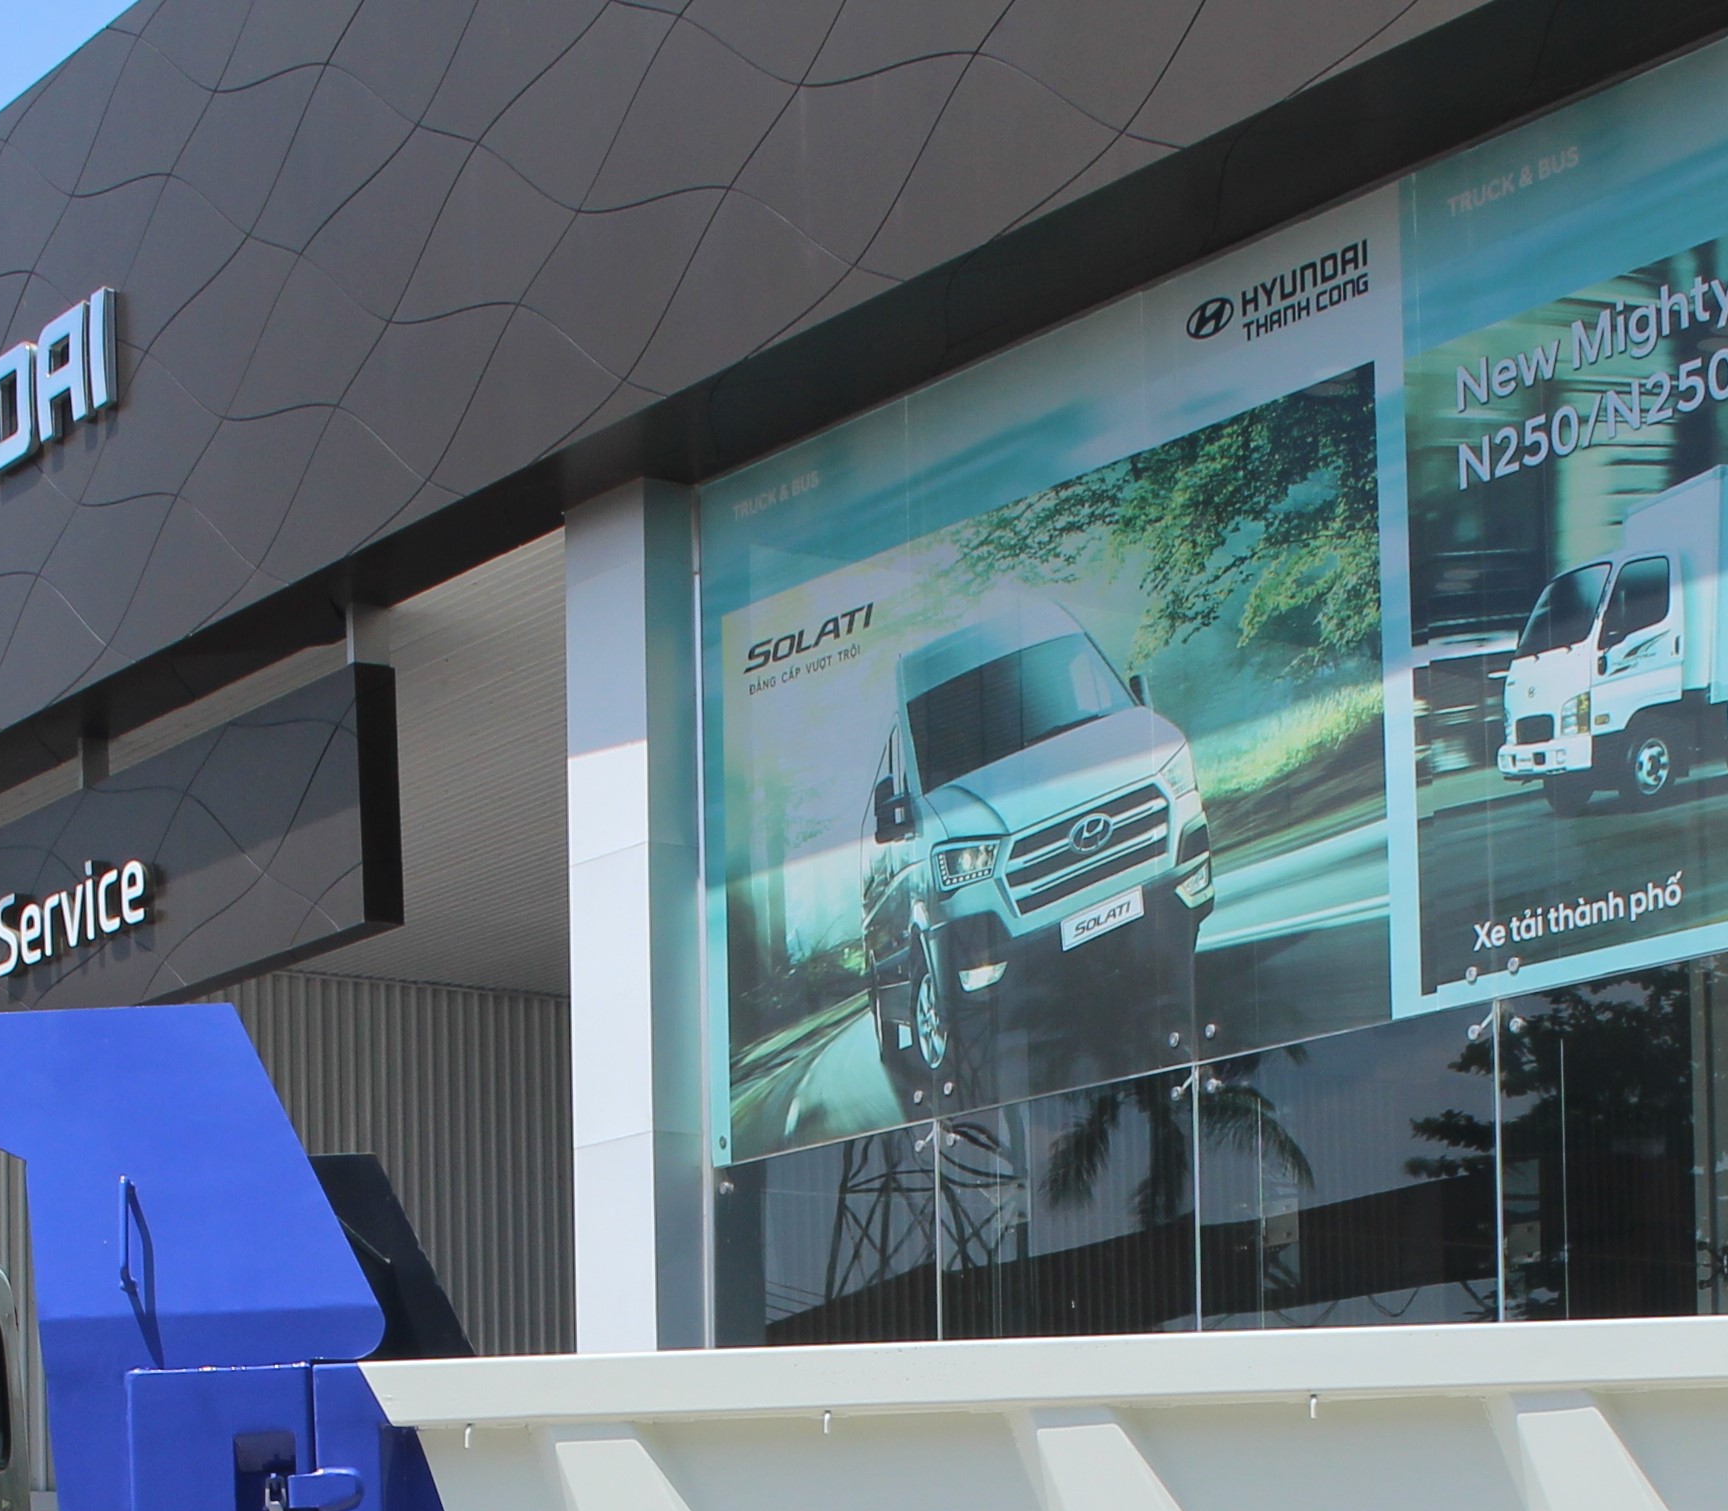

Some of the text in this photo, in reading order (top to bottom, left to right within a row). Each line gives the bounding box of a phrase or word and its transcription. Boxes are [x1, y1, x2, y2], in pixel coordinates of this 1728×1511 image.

[1447, 146, 1579, 217] TRUCK & BUS
[1241, 238, 1368, 317] HYUNDAI
[1243, 272, 1368, 341] THANH CONG
[1456, 339, 1560, 413] New
[743, 602, 874, 675] SOLATI
[1073, 900, 1131, 938] SOLATI
[1474, 870, 1683, 951] Xe tải thành phố
